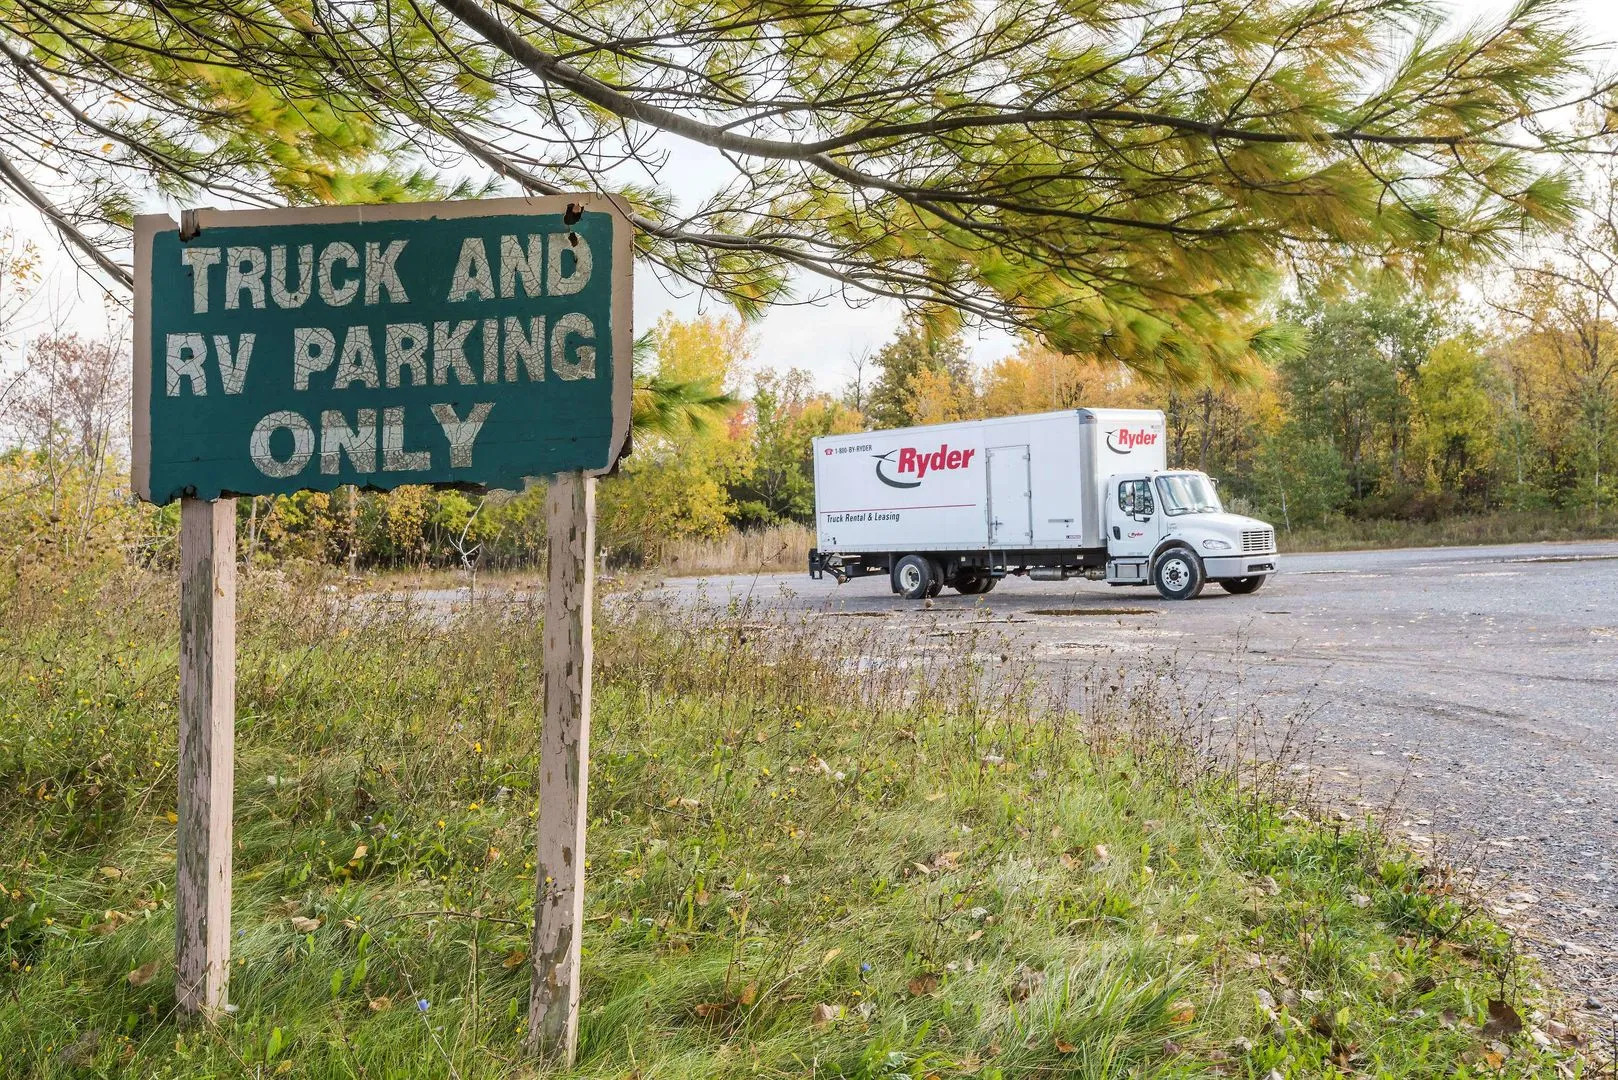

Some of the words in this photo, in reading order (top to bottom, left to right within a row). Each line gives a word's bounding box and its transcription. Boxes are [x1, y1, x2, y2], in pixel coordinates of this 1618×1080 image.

[181, 239, 410, 314] TRUCK
[447, 232, 593, 302] AND
[166, 332, 256, 397] RV
[293, 312, 596, 391] PARKING
[249, 402, 496, 479] ONLY
[897, 444, 976, 478] Ryder
[1118, 428, 1158, 448] Ryder
[827, 514, 844, 523] Truck
[845, 512, 866, 522] Rental
[867, 512, 873, 521] &
[874, 511, 900, 522] Leasing
